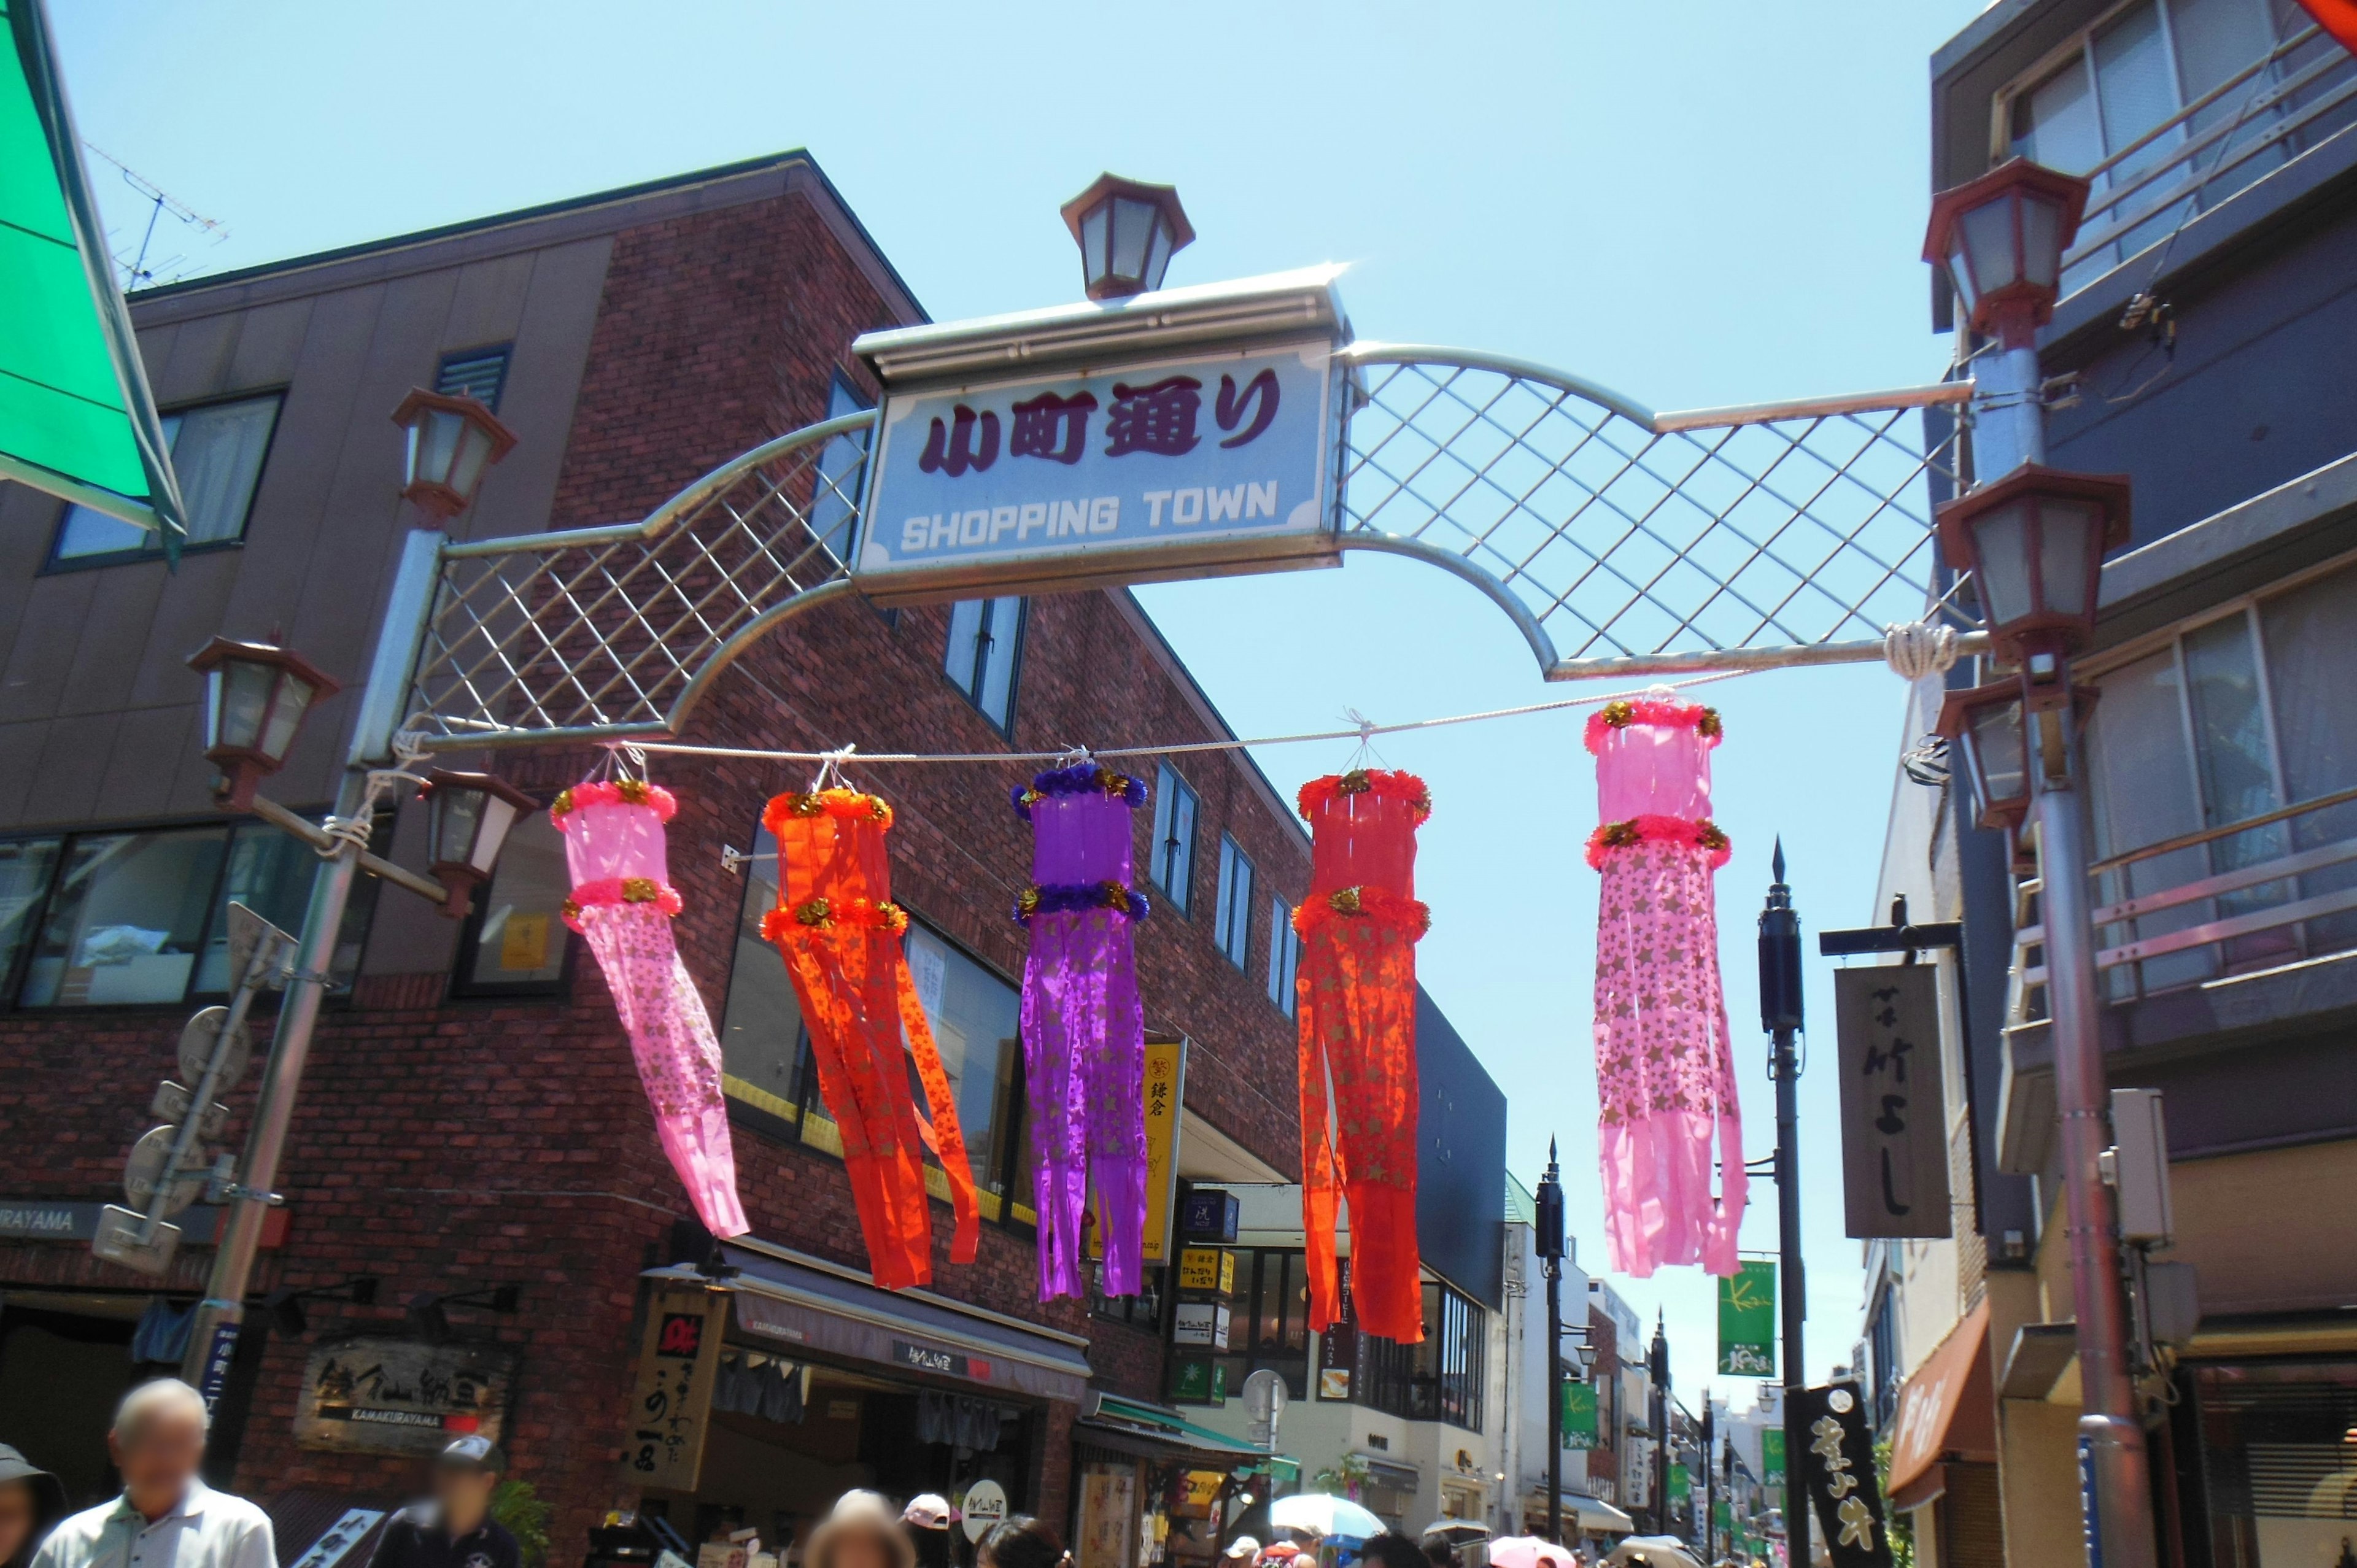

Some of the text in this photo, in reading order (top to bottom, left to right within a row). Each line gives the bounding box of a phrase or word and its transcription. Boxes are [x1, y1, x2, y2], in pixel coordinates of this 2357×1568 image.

[919, 369, 1280, 477] 小町通り
[901, 481, 1278, 552] SHOPPING TOWN
[1148, 1082, 1167, 1116] 鎌倉
[351, 1408, 439, 1427] KAMAKURAYAMA
[1810, 1415, 1876, 1551] 葉山牛
